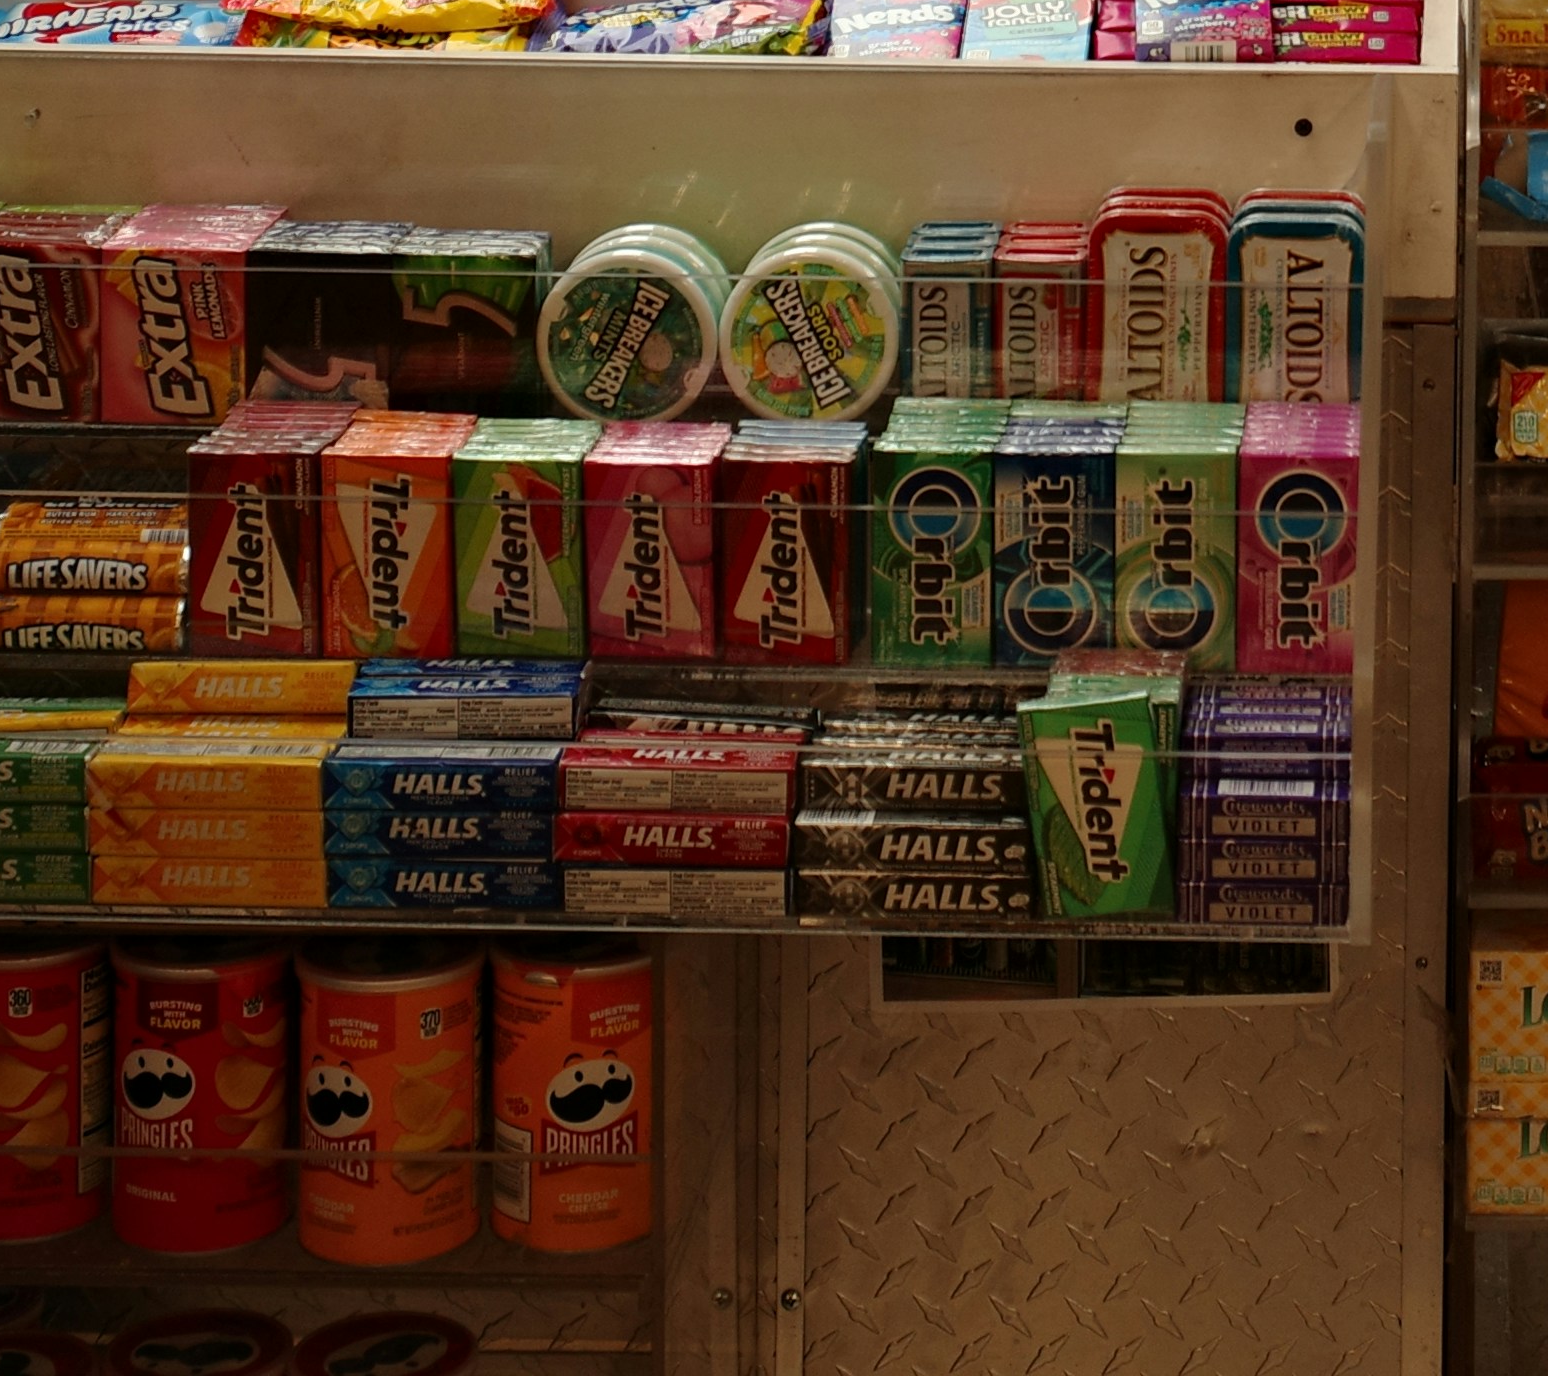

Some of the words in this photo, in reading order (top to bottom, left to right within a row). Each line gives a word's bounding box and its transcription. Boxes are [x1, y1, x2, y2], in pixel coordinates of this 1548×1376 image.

[982, 0, 1068, 20] JOLLY
[982, 12, 1076, 28] rancher
[134, 254, 213, 417] Extra
[1127, 246, 1169, 402] ALTOIDS
[226, 482, 264, 641] Trident
[369, 474, 411, 630] Trident
[492, 490, 530, 639] Trident
[6, 561, 58, 592] LIFE
[58, 559, 147, 592] SAVERS
[626, 492, 662, 641] Trident
[760, 491, 802, 648] Trident
[393, 773, 483, 798] HALLS
[886, 772, 1002, 800] HALLS
[1068, 718, 1128, 883] Trident
[390, 818, 479, 841] HALLS
[623, 826, 712, 849] HALLS
[1227, 819, 1300, 835] VIOLET
[880, 834, 996, 863] HALLS
[395, 871, 486, 894] HALLS
[1228, 860, 1300, 877] VIOLET
[149, 1016, 202, 1031] FLAVOR
